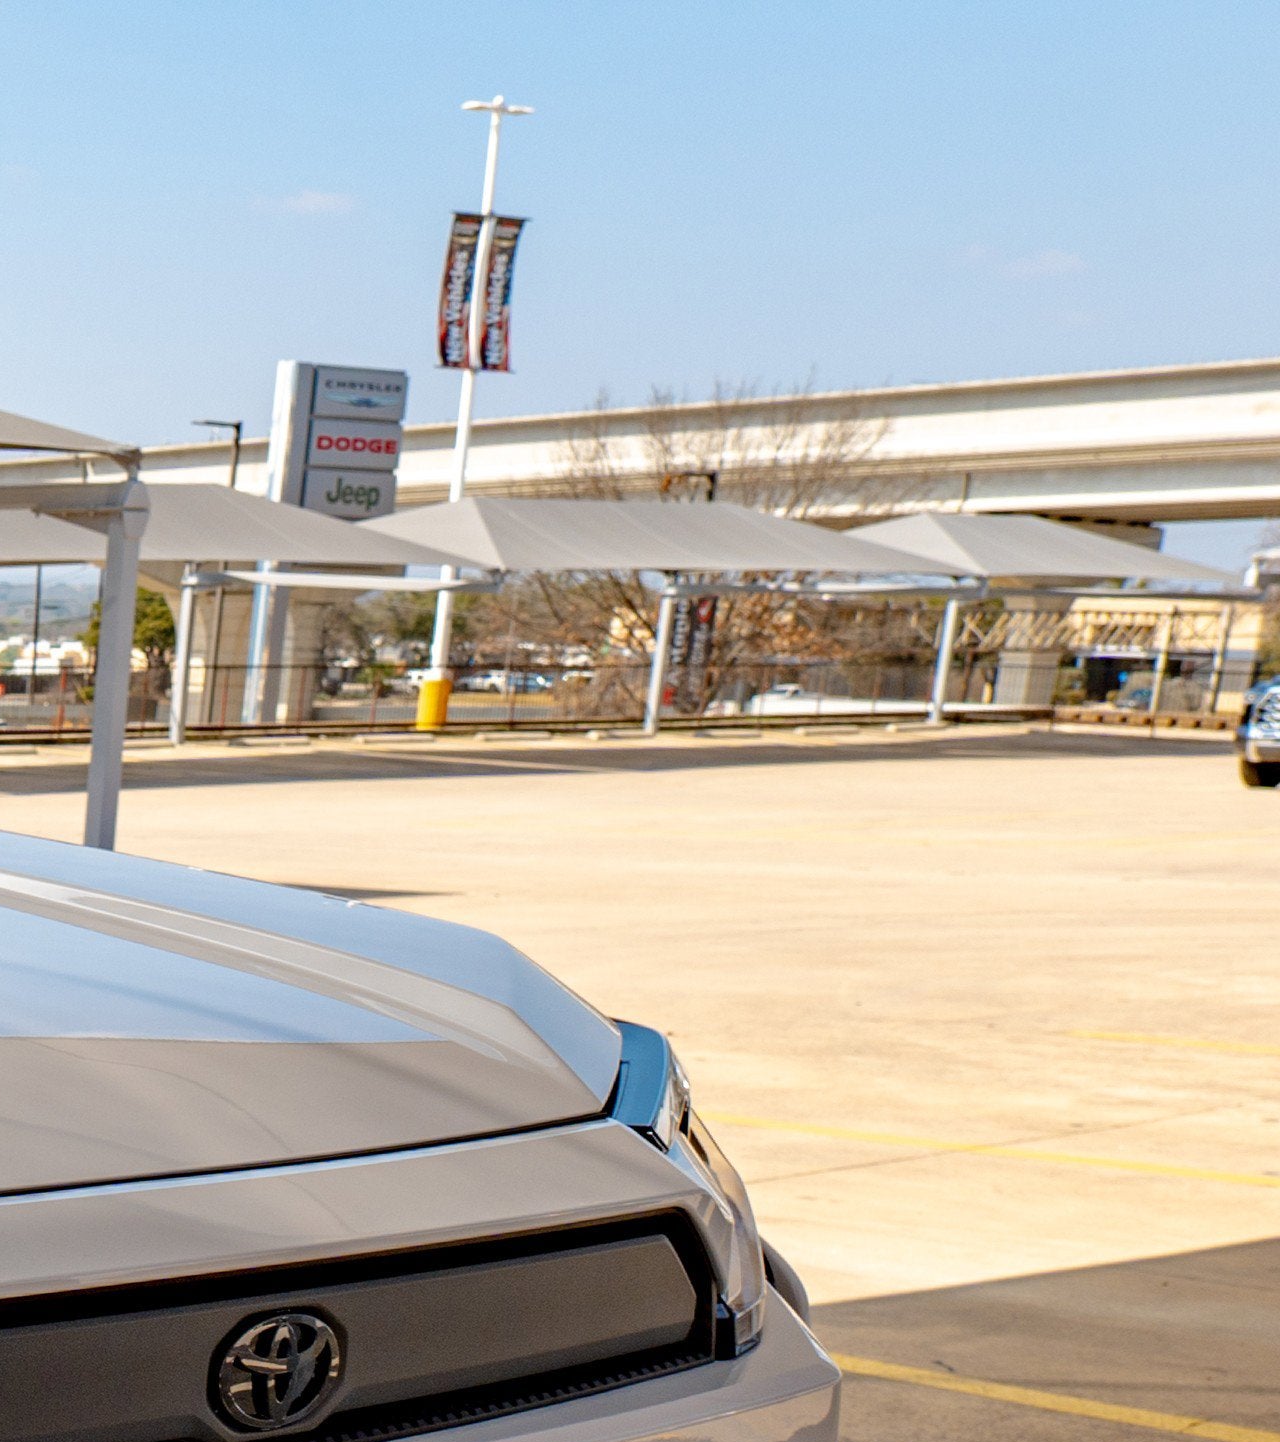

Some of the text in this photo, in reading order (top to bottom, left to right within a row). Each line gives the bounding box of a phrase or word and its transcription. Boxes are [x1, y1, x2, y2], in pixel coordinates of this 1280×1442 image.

[446, 251, 470, 324] Vehicles
[486, 253, 509, 324] Vehicles
[324, 379, 403, 393] CHRYSLER
[315, 435, 398, 455] DODGE
[326, 476, 381, 512] Jeep
